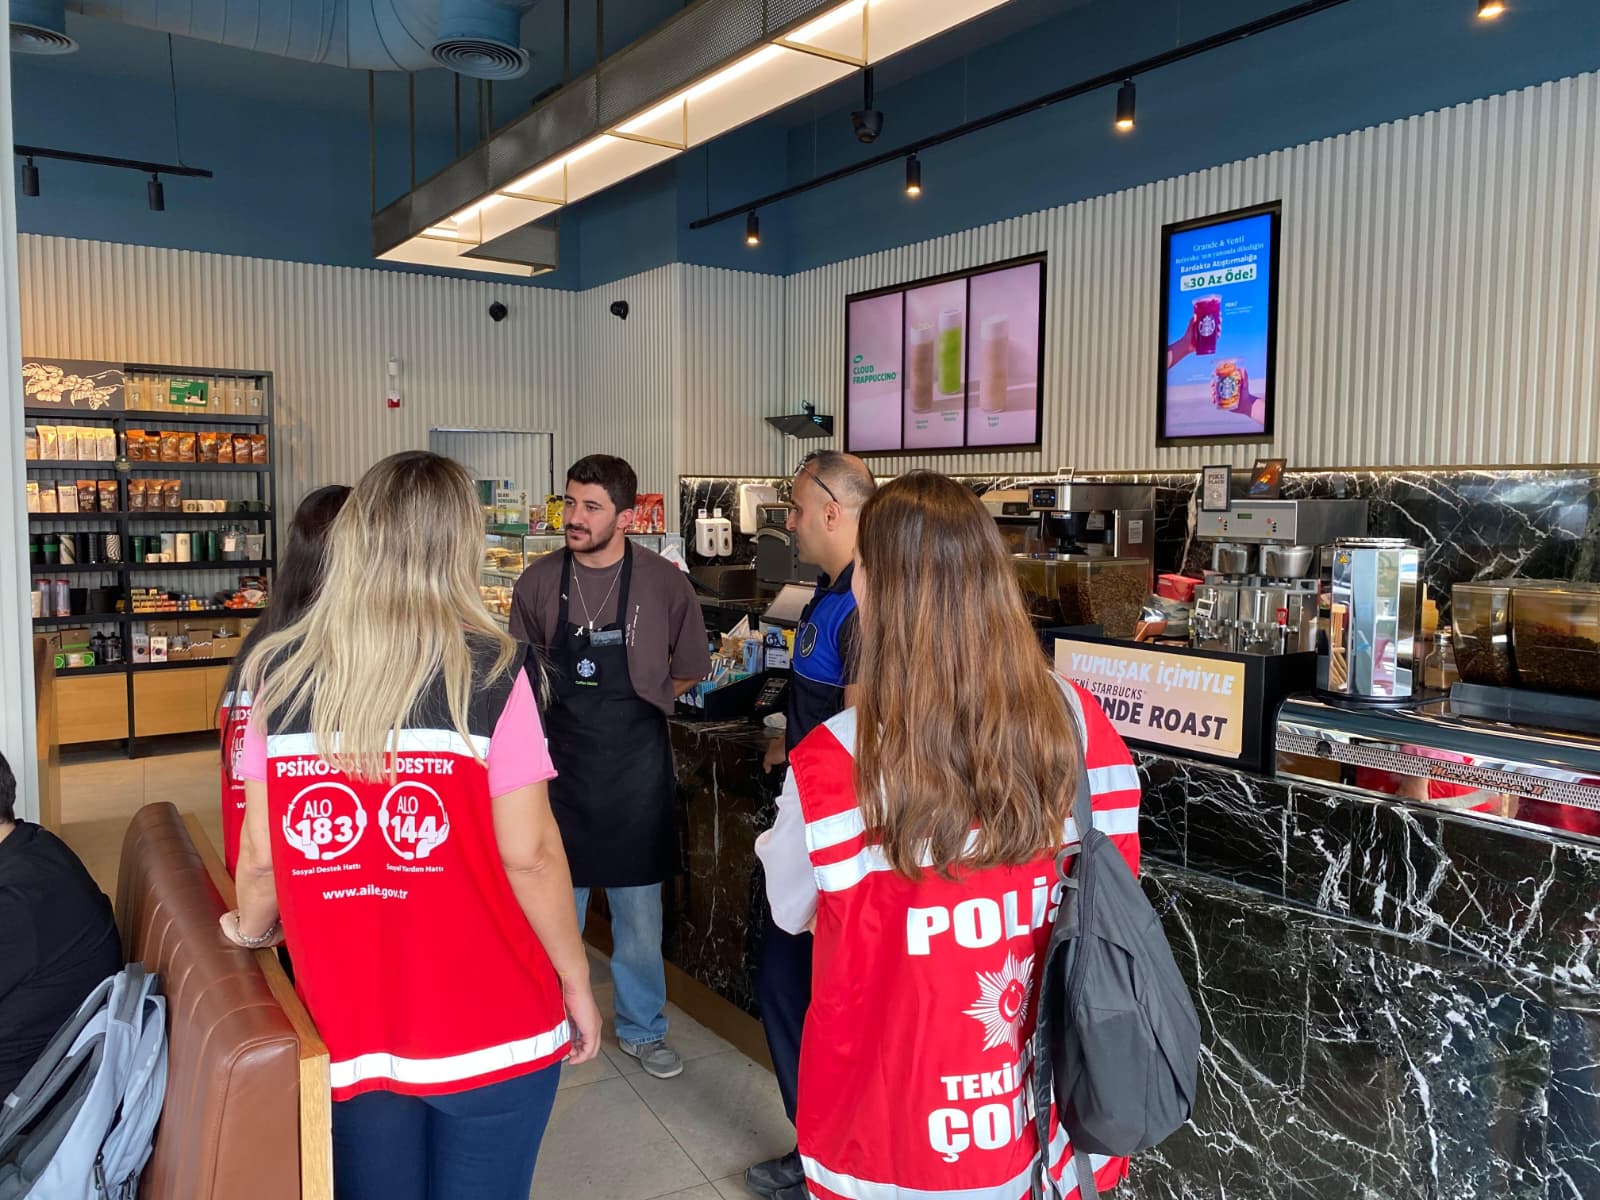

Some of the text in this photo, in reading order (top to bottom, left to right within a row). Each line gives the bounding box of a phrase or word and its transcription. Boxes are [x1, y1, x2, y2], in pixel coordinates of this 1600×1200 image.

[1180, 262, 1211, 273] Bardakta
[1208, 275, 1222, 286] Az
[1225, 268, 1253, 282] Öde!
[853, 365, 874, 375] CLOUD
[853, 372, 896, 384] FRAPPUCCINO
[1071, 653, 1153, 683] YUMUŞAK
[1091, 681, 1143, 700] STARBUCKS
[1149, 705, 1227, 740] ROAST
[396, 757, 454, 775] DESTEK
[302, 799, 332, 819] ALO
[397, 795, 419, 815] ALO
[295, 816, 353, 845] 183
[390, 815, 438, 844] 144
[292, 868, 315, 877] Sosyal
[316, 865, 341, 874] Destek
[322, 884, 408, 900] www.aile.gov.tr
